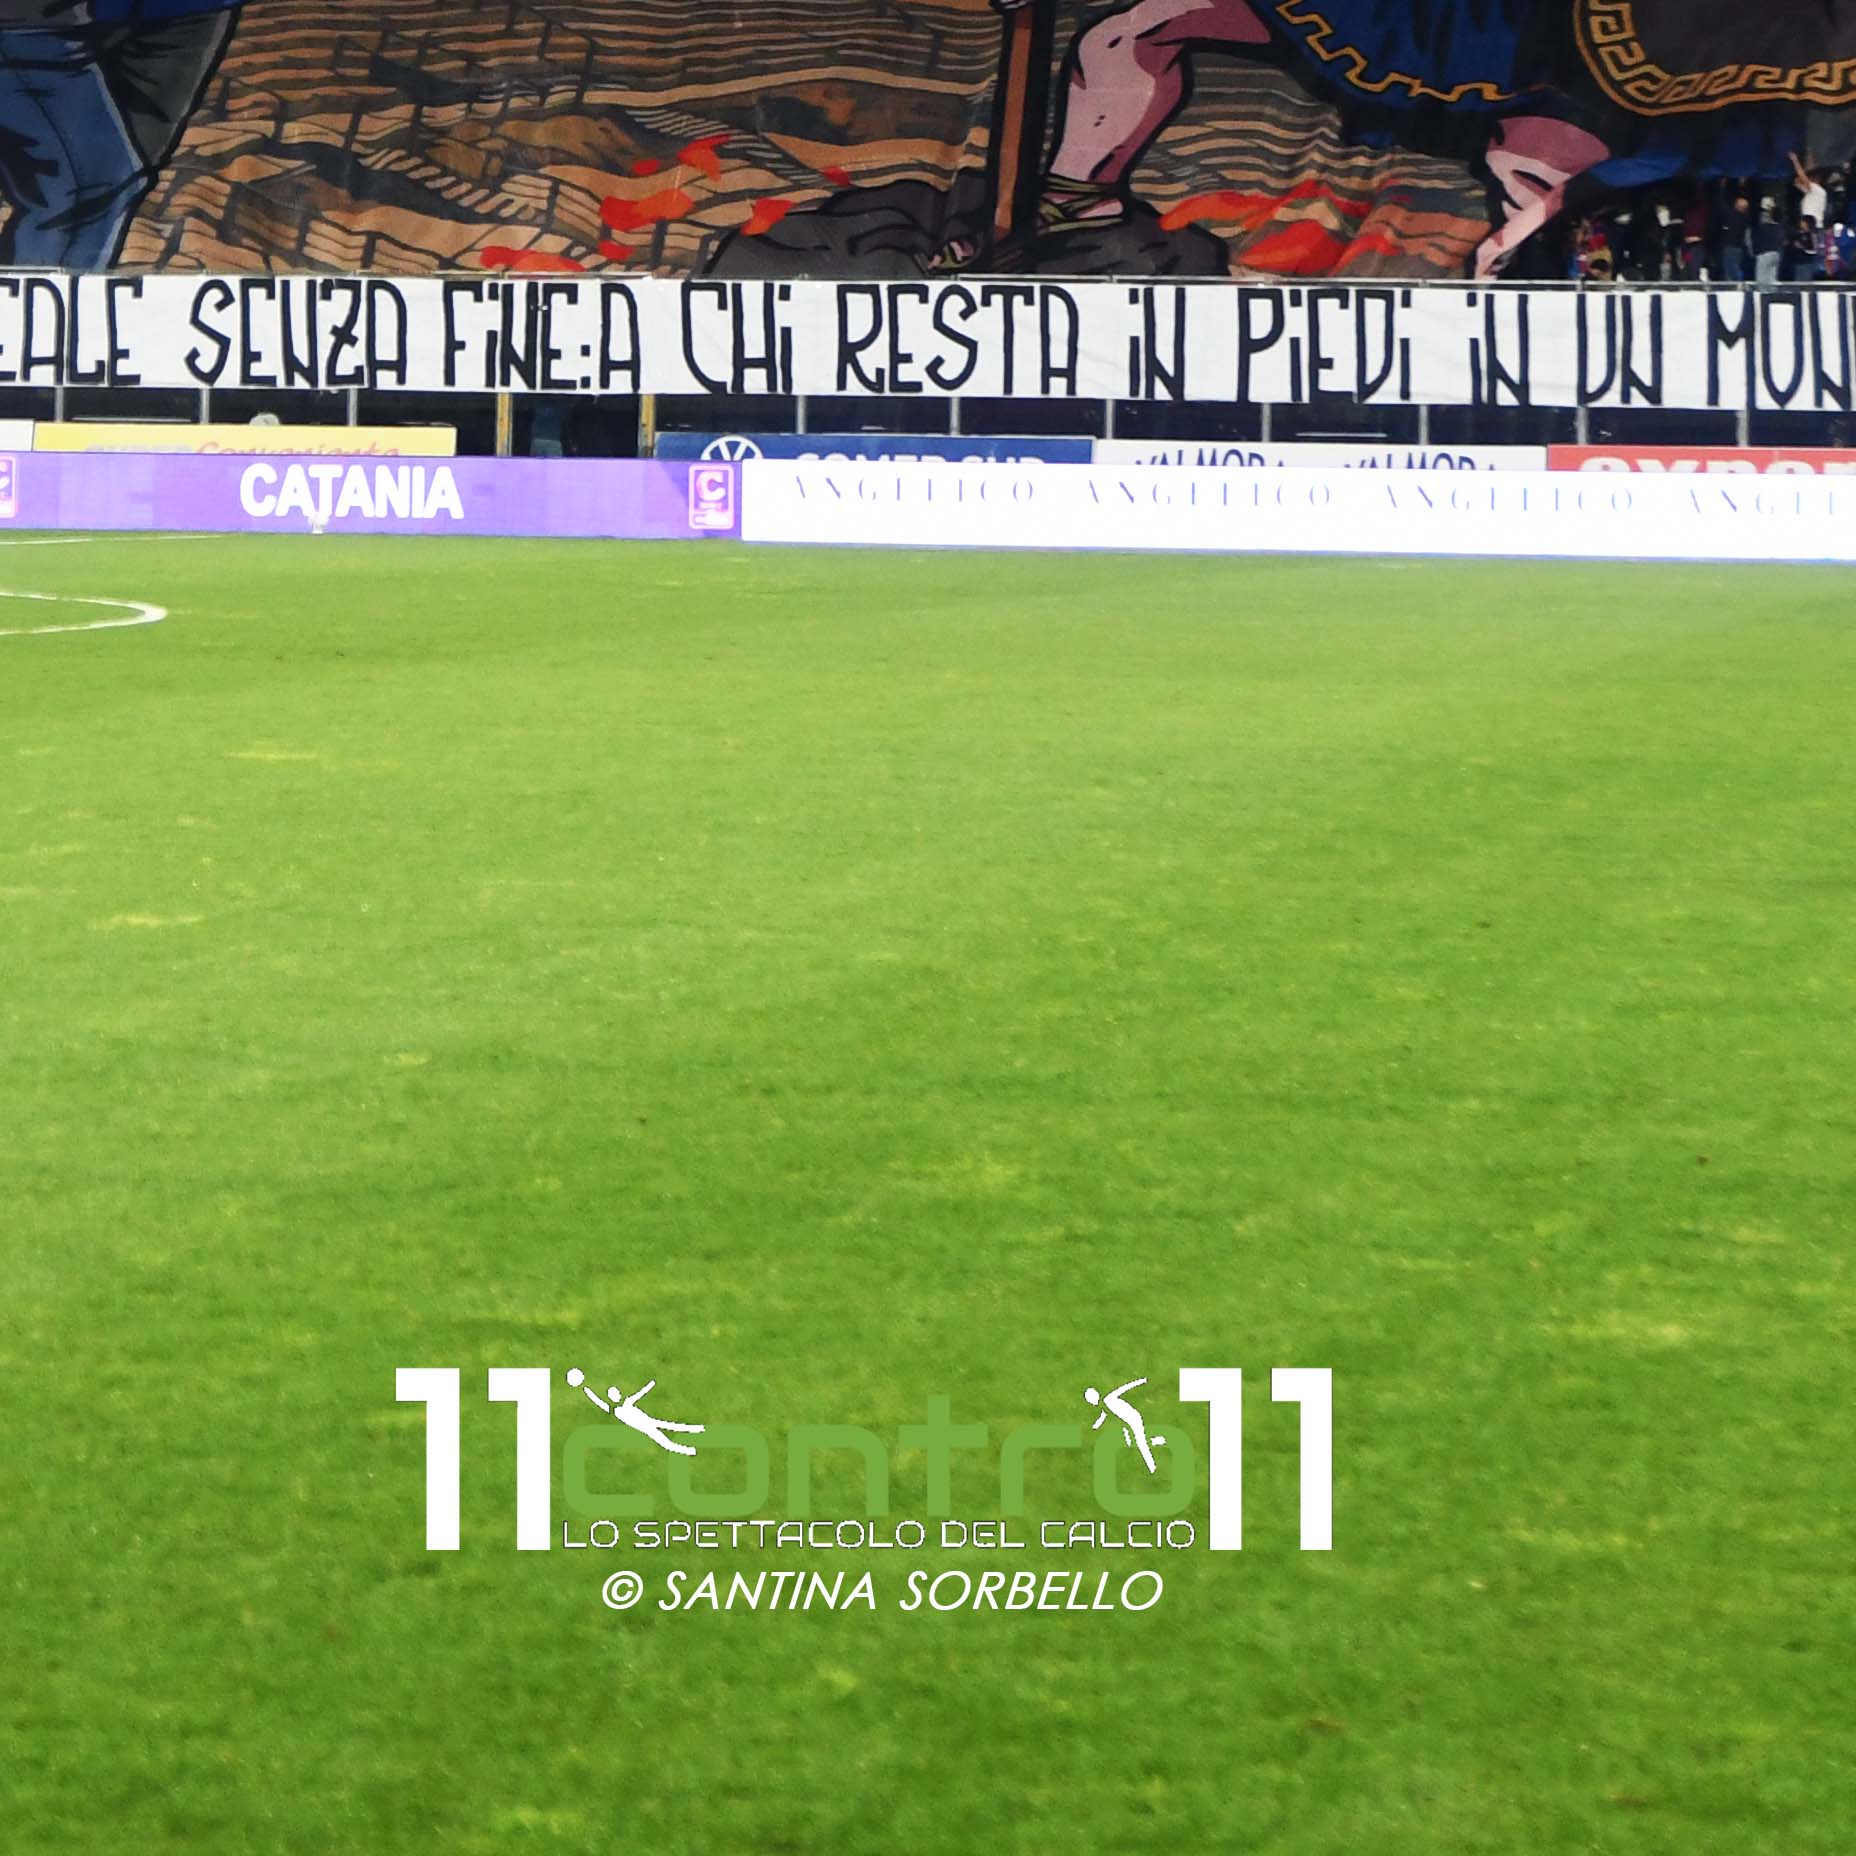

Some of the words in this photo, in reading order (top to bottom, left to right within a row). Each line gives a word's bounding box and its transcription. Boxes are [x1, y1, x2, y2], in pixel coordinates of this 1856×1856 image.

[184, 277, 408, 388] SENZA
[836, 282, 1080, 396] RESTA
[1576, 292, 1663, 407] UN
[239, 462, 465, 522] CATANIA
